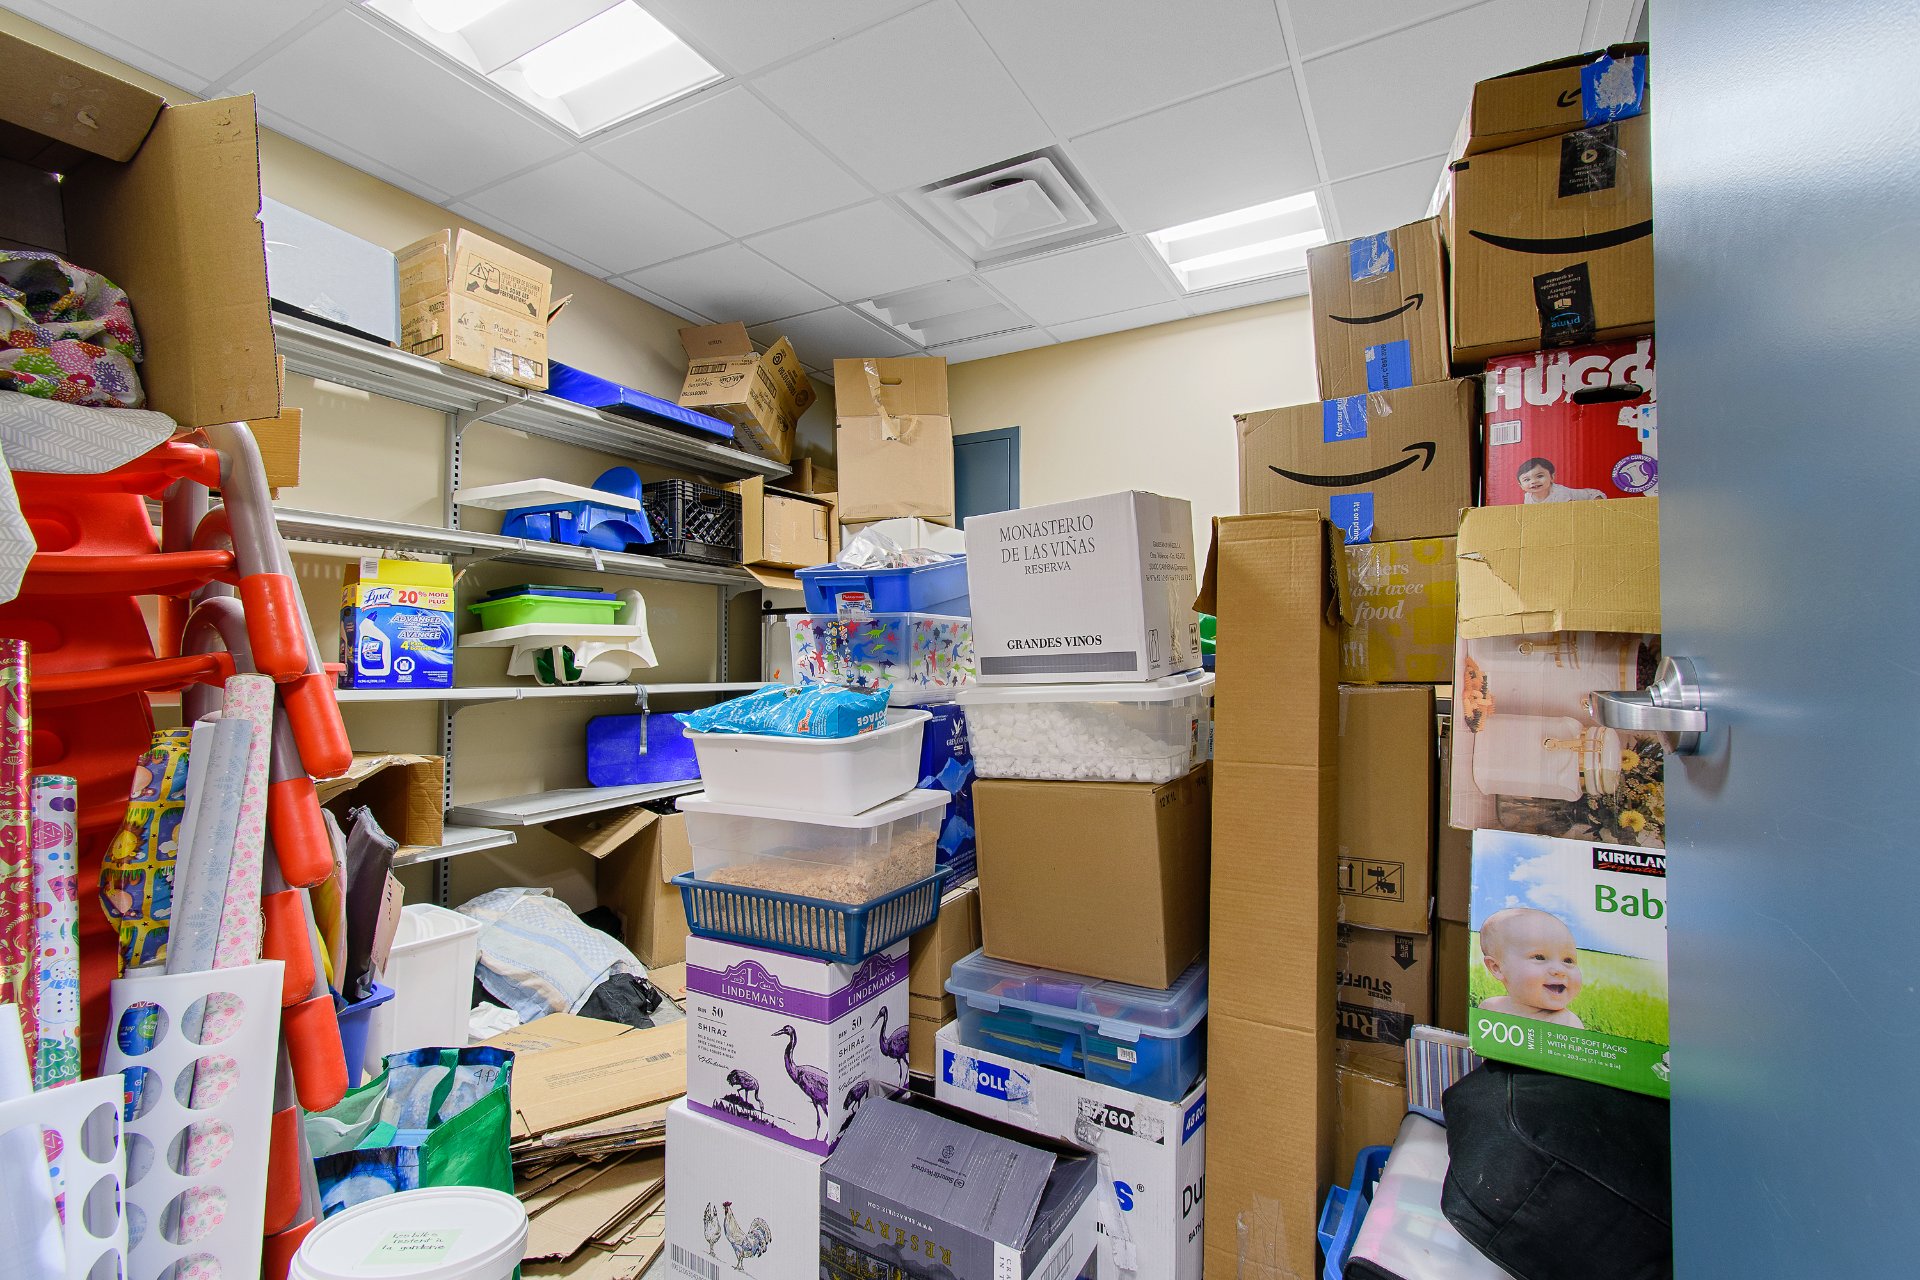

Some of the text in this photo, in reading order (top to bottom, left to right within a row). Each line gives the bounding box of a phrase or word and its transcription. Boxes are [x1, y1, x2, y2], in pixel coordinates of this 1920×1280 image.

[1551, 316, 1580, 328] prime
[1000, 514, 1094, 542] MONASTERIO
[1001, 536, 1096, 563] DE LAS VIÑAS
[1024, 561, 1072, 575] RESERVA
[364, 588, 394, 605] Lysol
[1385, 583, 1424, 596] avec
[392, 615, 443, 623] ADVANCED
[1354, 600, 1405, 628] food
[401, 641, 409, 651] 4
[1007, 635, 1102, 650] GRANDES VINOS
[1595, 884, 1667, 920] Bab
[1396, 937, 1413, 945] HAUT
[721, 983, 784, 1007] LINDEMAN'S
[848, 971, 896, 1006] LINDEMAN'S
[1367, 990, 1393, 1002] CHEESE
[711, 1006, 724, 1018] 50
[697, 1022, 728, 1037] SHIRAZ
[851, 1015, 862, 1030] 50
[1478, 1018, 1525, 1047] 900
[838, 1035, 865, 1058] SHIRAZ
[1547, 1040, 1617, 1060] WITH FLIP-TOP LIDS
[1570, 1036, 1581, 1044] CT
[1581, 1037, 1601, 1049] SOFT
[1602, 1042, 1628, 1054] PACKS
[849, 1208, 952, 1267] RESERVA
